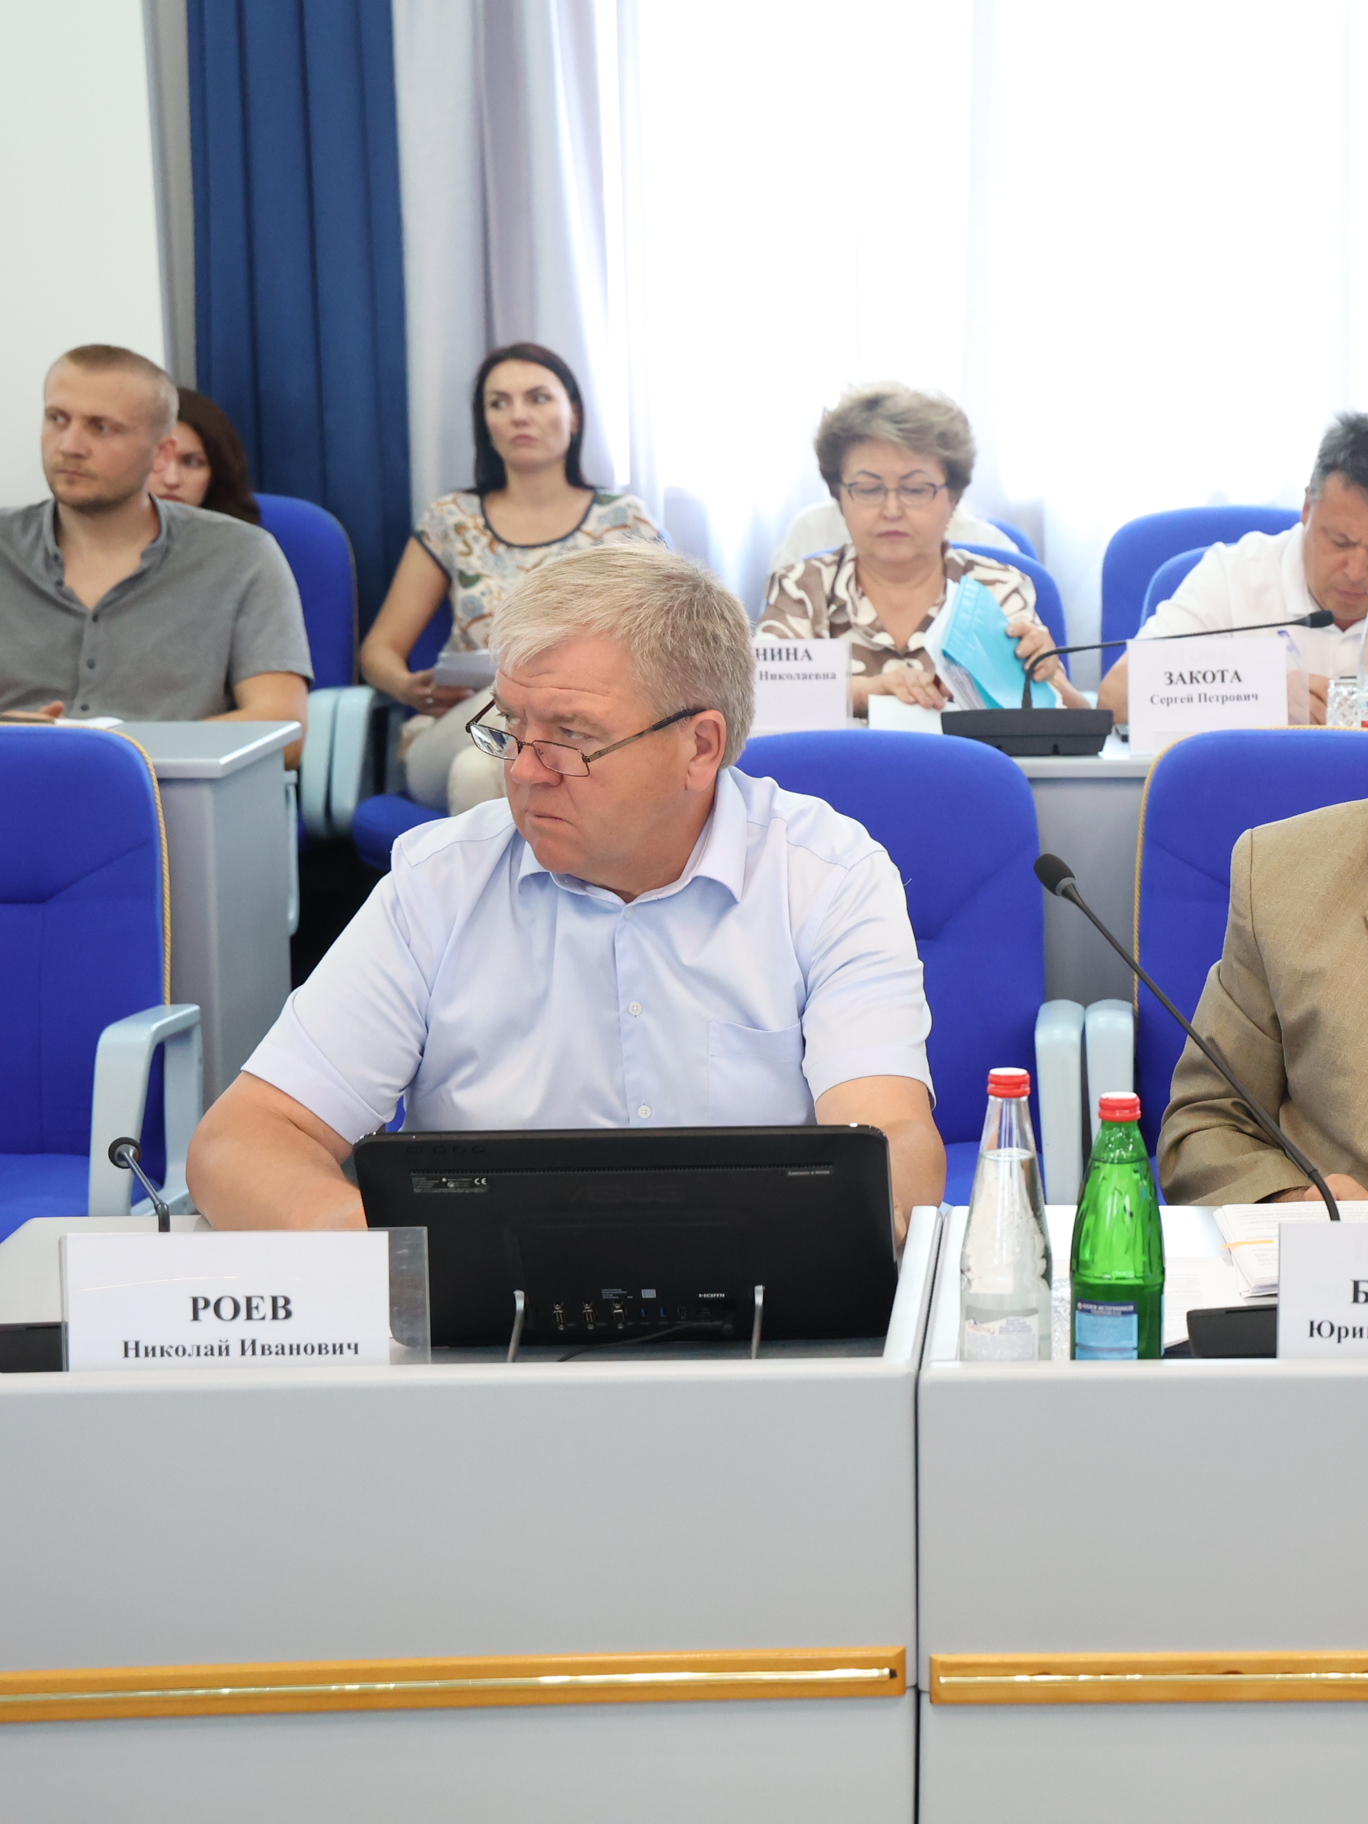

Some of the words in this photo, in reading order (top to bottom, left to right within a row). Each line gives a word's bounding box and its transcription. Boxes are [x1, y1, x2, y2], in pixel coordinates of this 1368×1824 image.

[758, 670, 837, 681] Николаевна
[1163, 669, 1243, 686] ЗАКОТА
[1149, 693, 1194, 708] Сергей
[1197, 692, 1259, 706] Петрович
[189, 1295, 294, 1323] РОЕВ
[122, 1339, 231, 1360] Николай
[239, 1338, 361, 1358] Иванович
